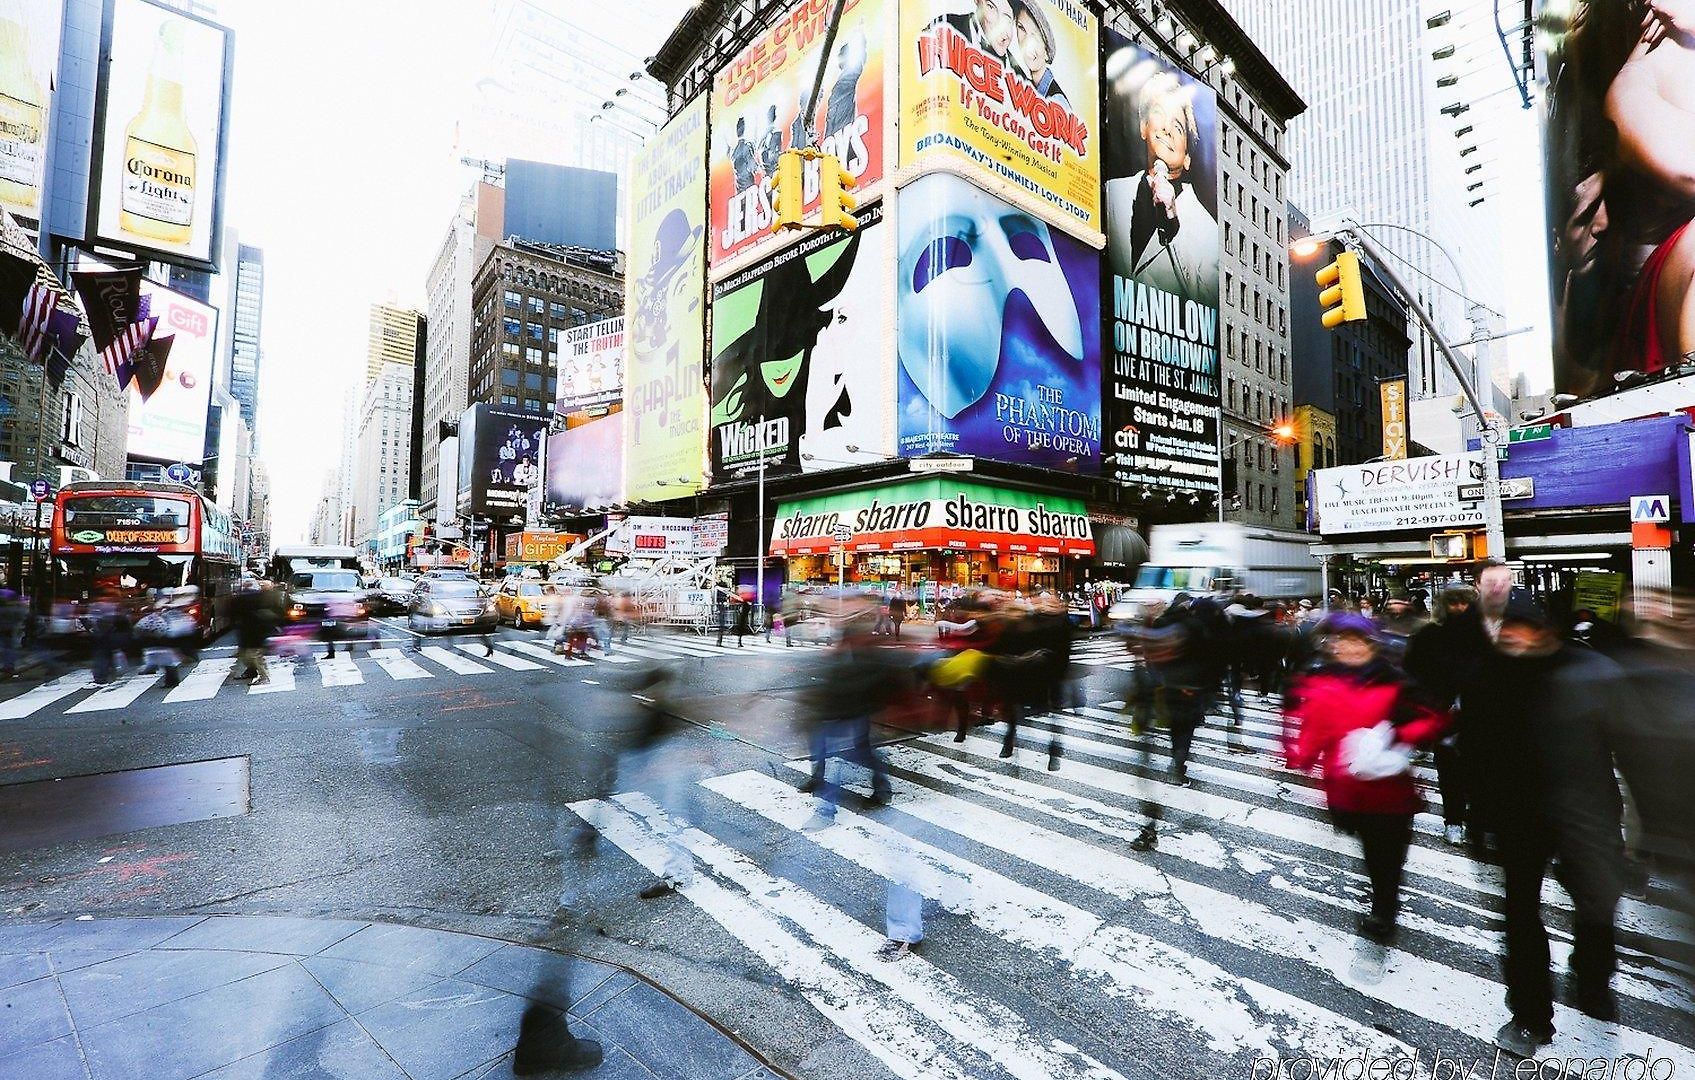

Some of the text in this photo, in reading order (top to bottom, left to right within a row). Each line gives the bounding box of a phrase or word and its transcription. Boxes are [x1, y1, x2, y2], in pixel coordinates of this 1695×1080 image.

[724, 44, 787, 107] GOES
[725, 43, 767, 84] THE
[918, 28, 1088, 157] NICE WORK
[976, 96, 1000, 126] You
[1001, 112, 1026, 140] Can
[1027, 131, 1050, 158] Get
[1051, 143, 1063, 163] It
[127, 157, 193, 190] Corona
[916, 132, 993, 169] BROADWAY'S
[995, 161, 1039, 194] FUNNIEST
[1041, 187, 1063, 209] LOVE
[1065, 201, 1090, 222] STORY
[1031, 157, 1058, 179] Musical
[741, 260, 774, 283] HAPPENED
[773, 248, 799, 268] BEFORE
[170, 308, 204, 336] Gift
[1113, 274, 1217, 346] MANILOW
[566, 325, 594, 344] START
[573, 333, 623, 356] THE TRUTH!
[1114, 321, 1218, 376] ON BROADWAY
[1114, 353, 1219, 398] LIVE AT THE ST. JAMES
[1037, 384, 1063, 405] THE
[1114, 382, 1219, 419] Limited Engagement
[995, 392, 1098, 442] PHANTOM
[1133, 405, 1204, 434] Starts Jan. 18
[1386, 384, 1404, 459] Stay
[1003, 425, 1091, 456] OF THE OPERA
[1114, 429, 1140, 449] citi
[1516, 429, 1526, 440] 7
[1361, 459, 1461, 488] DERVISH
[116, 518, 141, 526] 71510
[780, 511, 840, 539] sbarro
[853, 500, 931, 532] sbarro
[945, 495, 1018, 532] sbarro
[1028, 506, 1087, 538] sbarro
[1396, 513, 1483, 526] 212-997-0070
[525, 543, 564, 555] GIFTS
